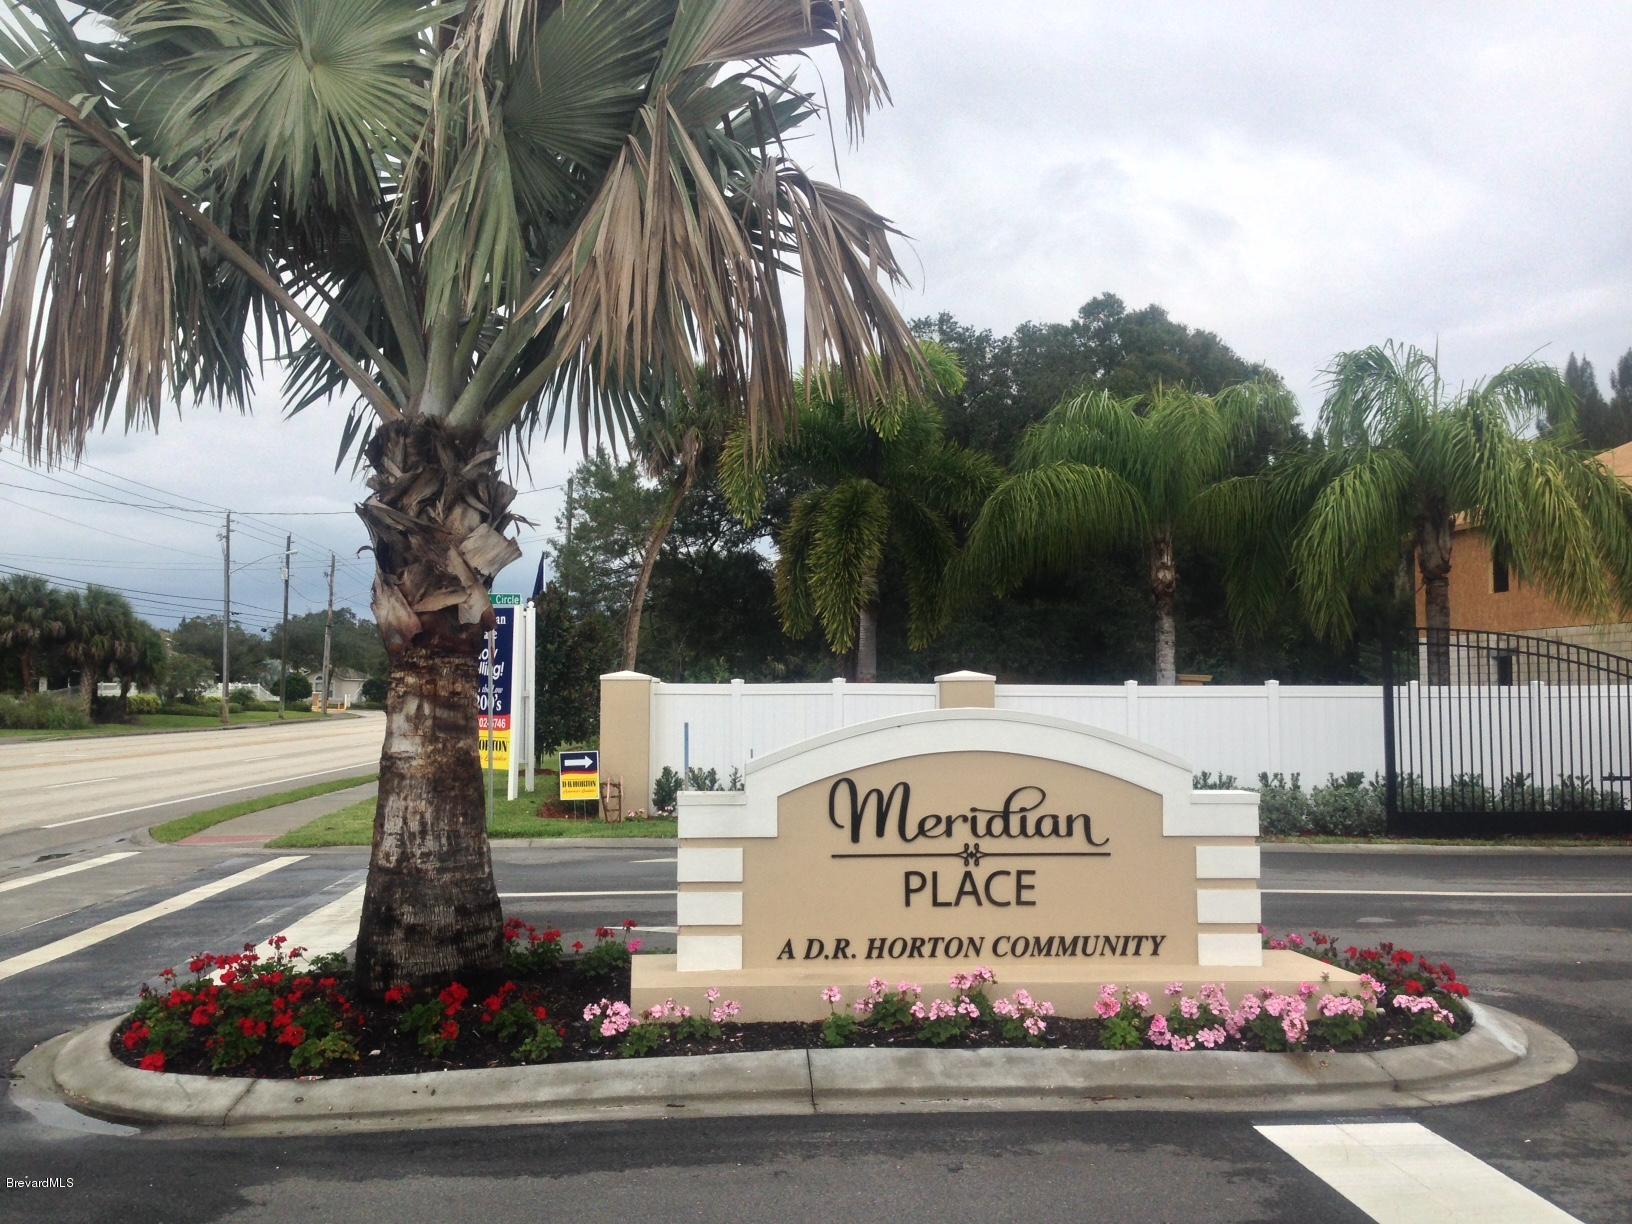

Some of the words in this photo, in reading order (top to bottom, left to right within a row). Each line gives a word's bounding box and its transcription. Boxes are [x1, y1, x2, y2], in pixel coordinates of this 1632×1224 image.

[495, 594, 520, 605] Circle
[478, 717, 506, 729] 02-746
[828, 777, 1110, 846] Meridian
[904, 870, 1037, 908] PLACE
[777, 938, 797, 961] A
[803, 938, 857, 961] D.R.
[864, 937, 987, 960] HORTON
[992, 935, 1168, 959] COMMUNITY
